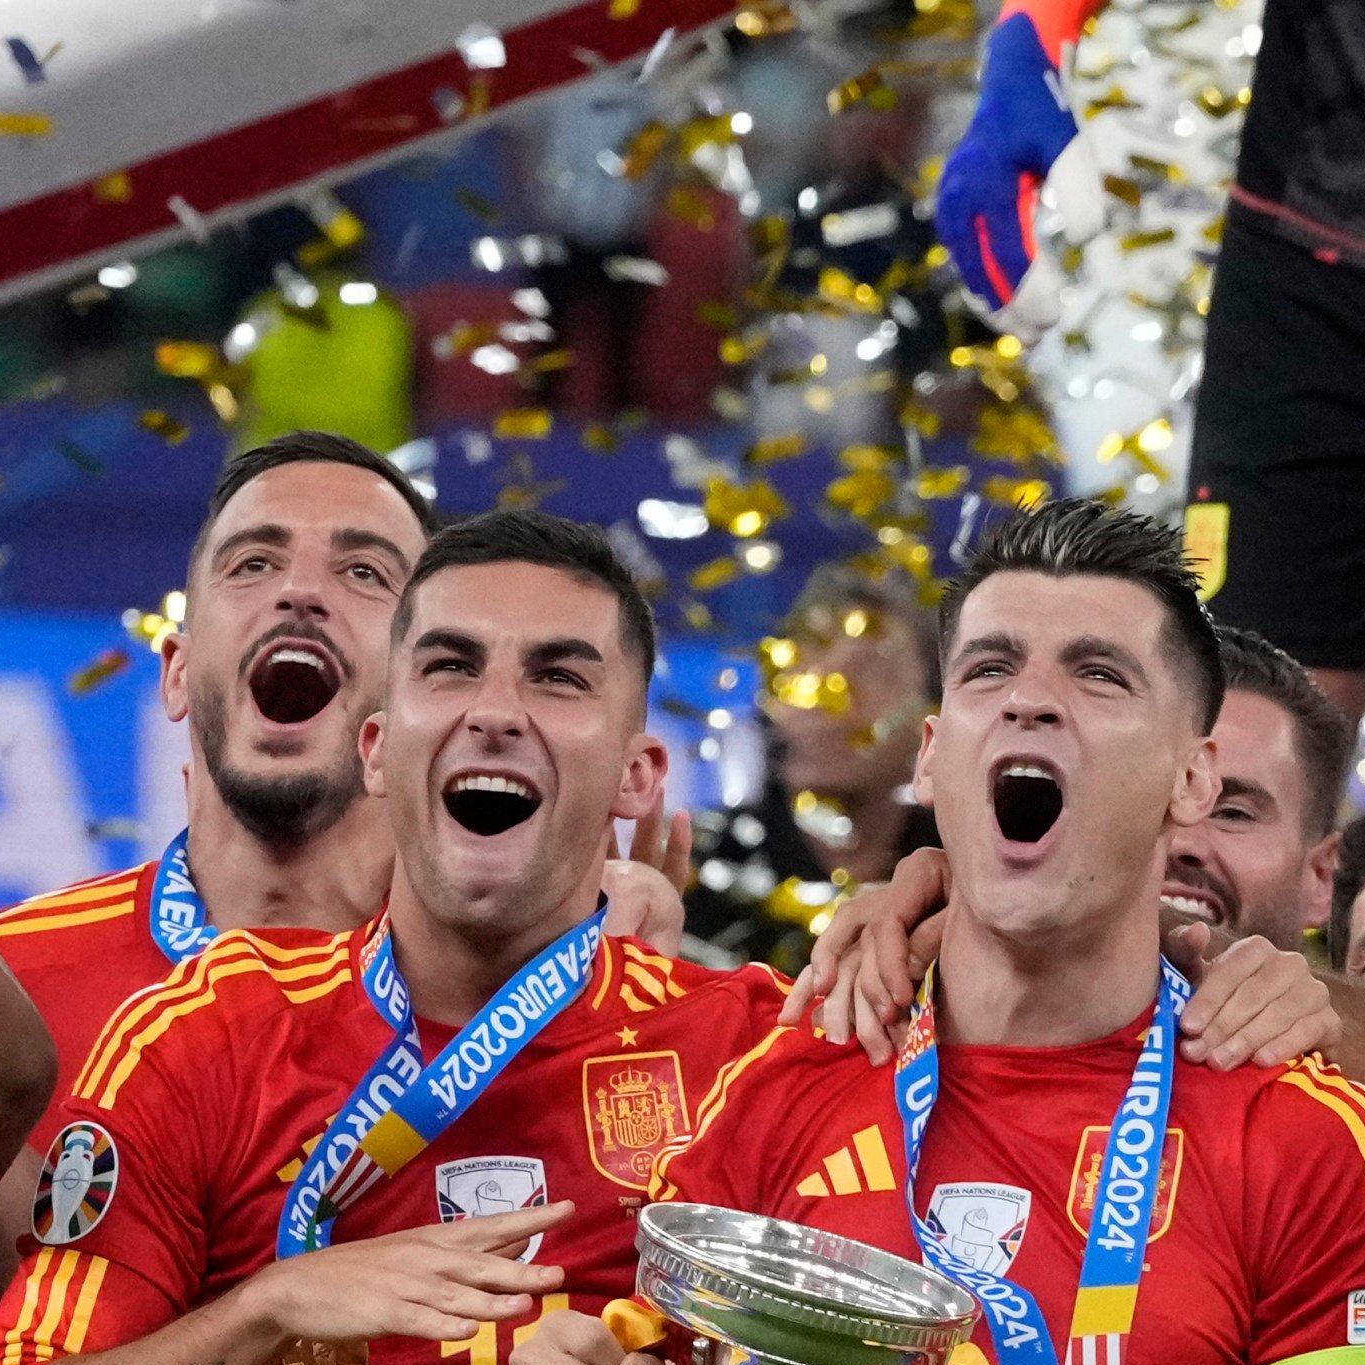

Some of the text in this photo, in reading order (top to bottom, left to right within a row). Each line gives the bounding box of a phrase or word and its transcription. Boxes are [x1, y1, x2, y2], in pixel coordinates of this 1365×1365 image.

[427, 963, 568, 1111] EURO2024
[464, 1160, 503, 1171] NATIONS
[503, 1160, 538, 1171] LEAGUE
[939, 1187, 1027, 1202] UEFA NATIONS LEAGUE
